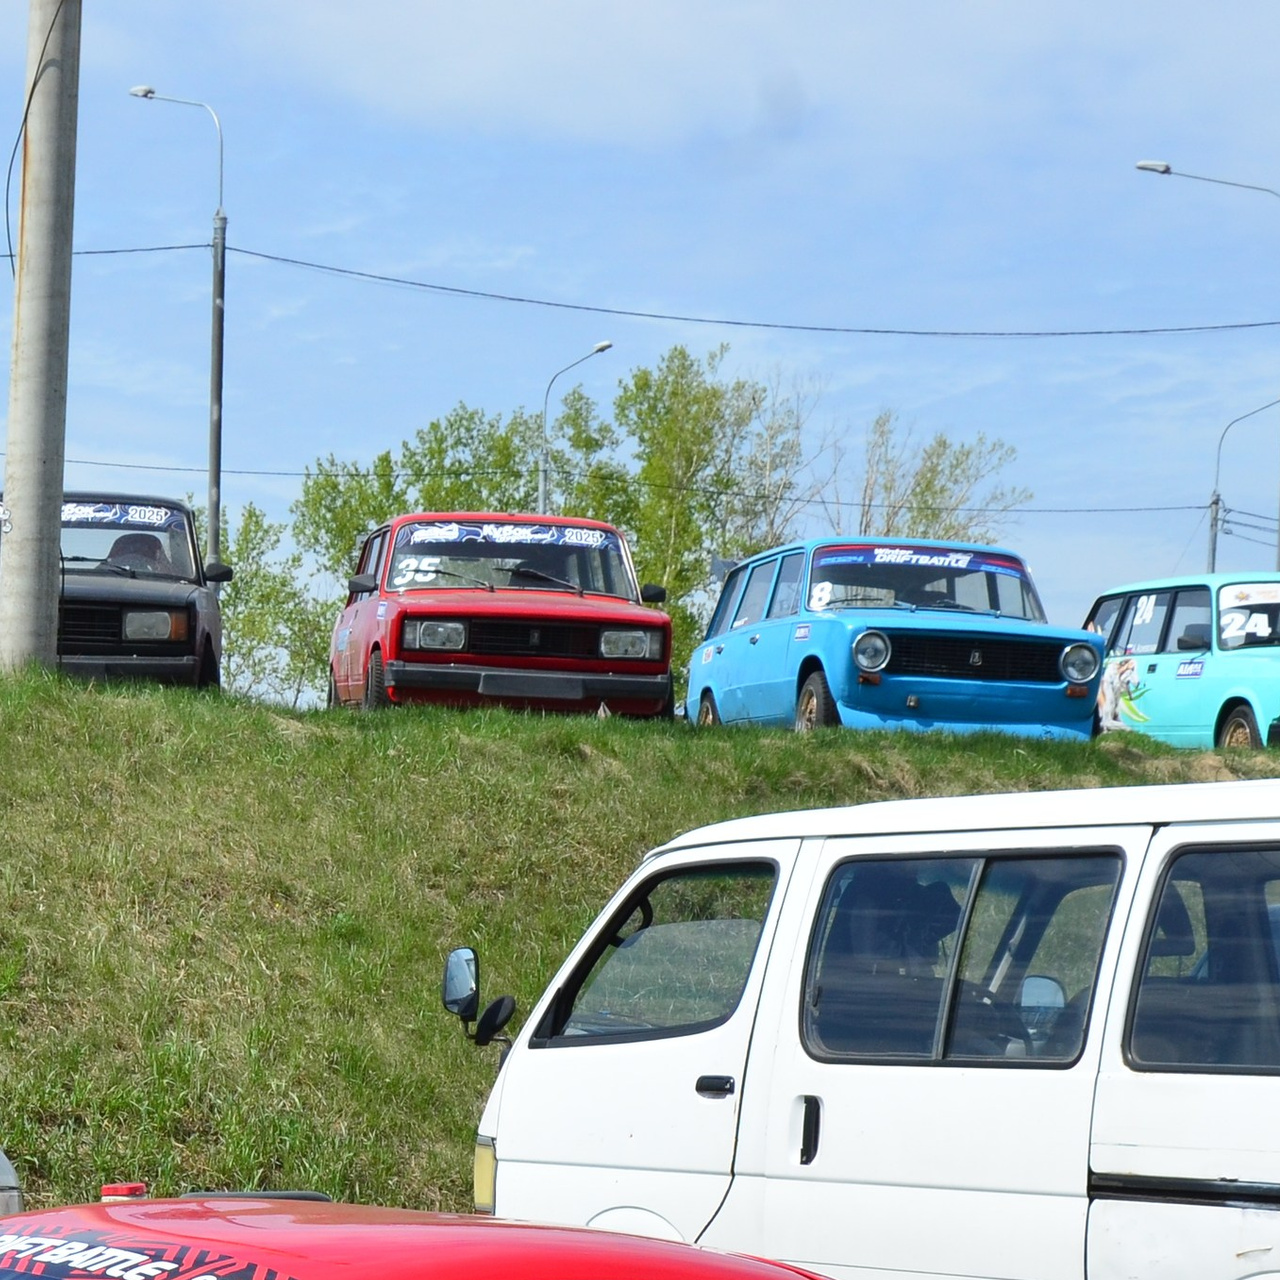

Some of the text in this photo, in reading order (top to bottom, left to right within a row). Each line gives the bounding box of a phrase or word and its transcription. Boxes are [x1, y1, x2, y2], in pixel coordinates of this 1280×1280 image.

[129, 506, 164, 522] 2025
[566, 528, 600, 544] 2025
[394, 557, 441, 586] 35
[810, 581, 833, 610] 8
[1133, 594, 1157, 626] 24
[1221, 612, 1272, 640] 24
